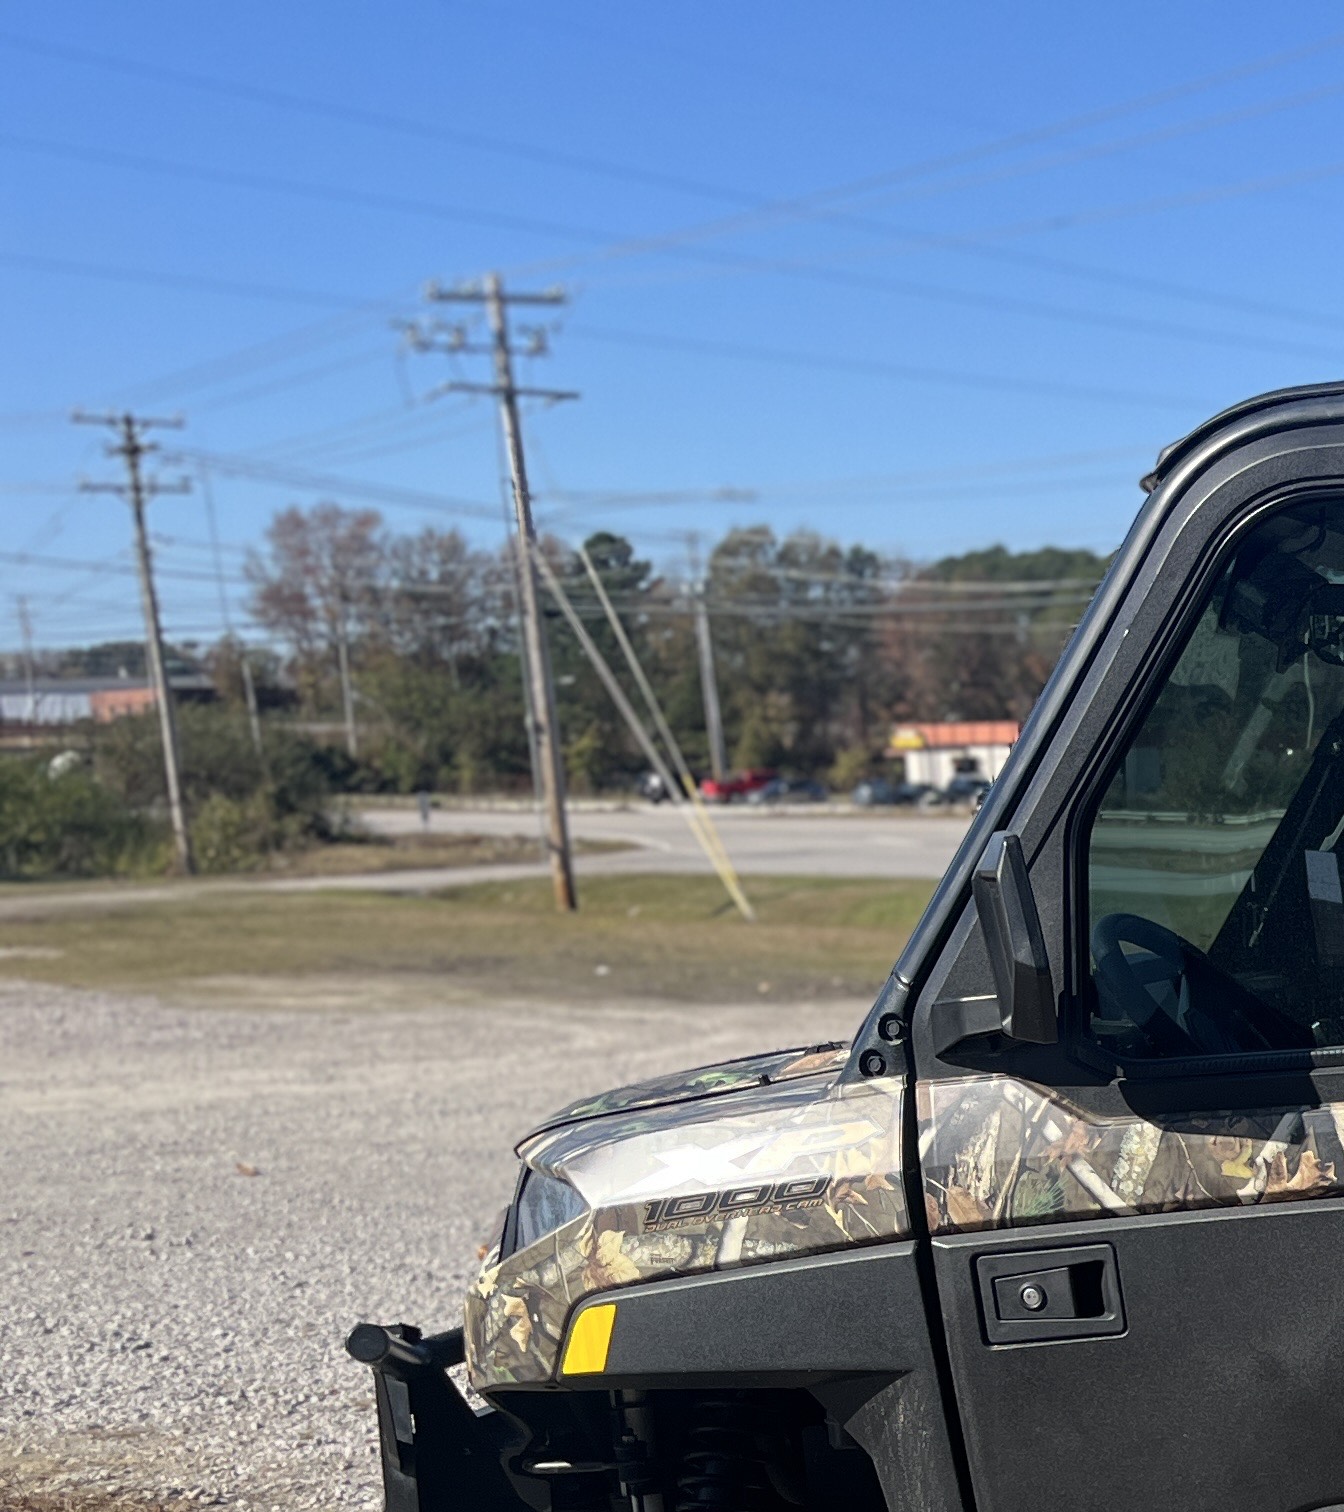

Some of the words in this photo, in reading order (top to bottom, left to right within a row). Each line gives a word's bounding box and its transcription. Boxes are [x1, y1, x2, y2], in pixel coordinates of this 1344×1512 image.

[604, 1116, 886, 1200] XP
[643, 1173, 834, 1224] 1000
[645, 1218, 687, 1233] DUAL
[692, 1203, 782, 1226] OVERHEAD
[785, 1198, 823, 1211] CAM
